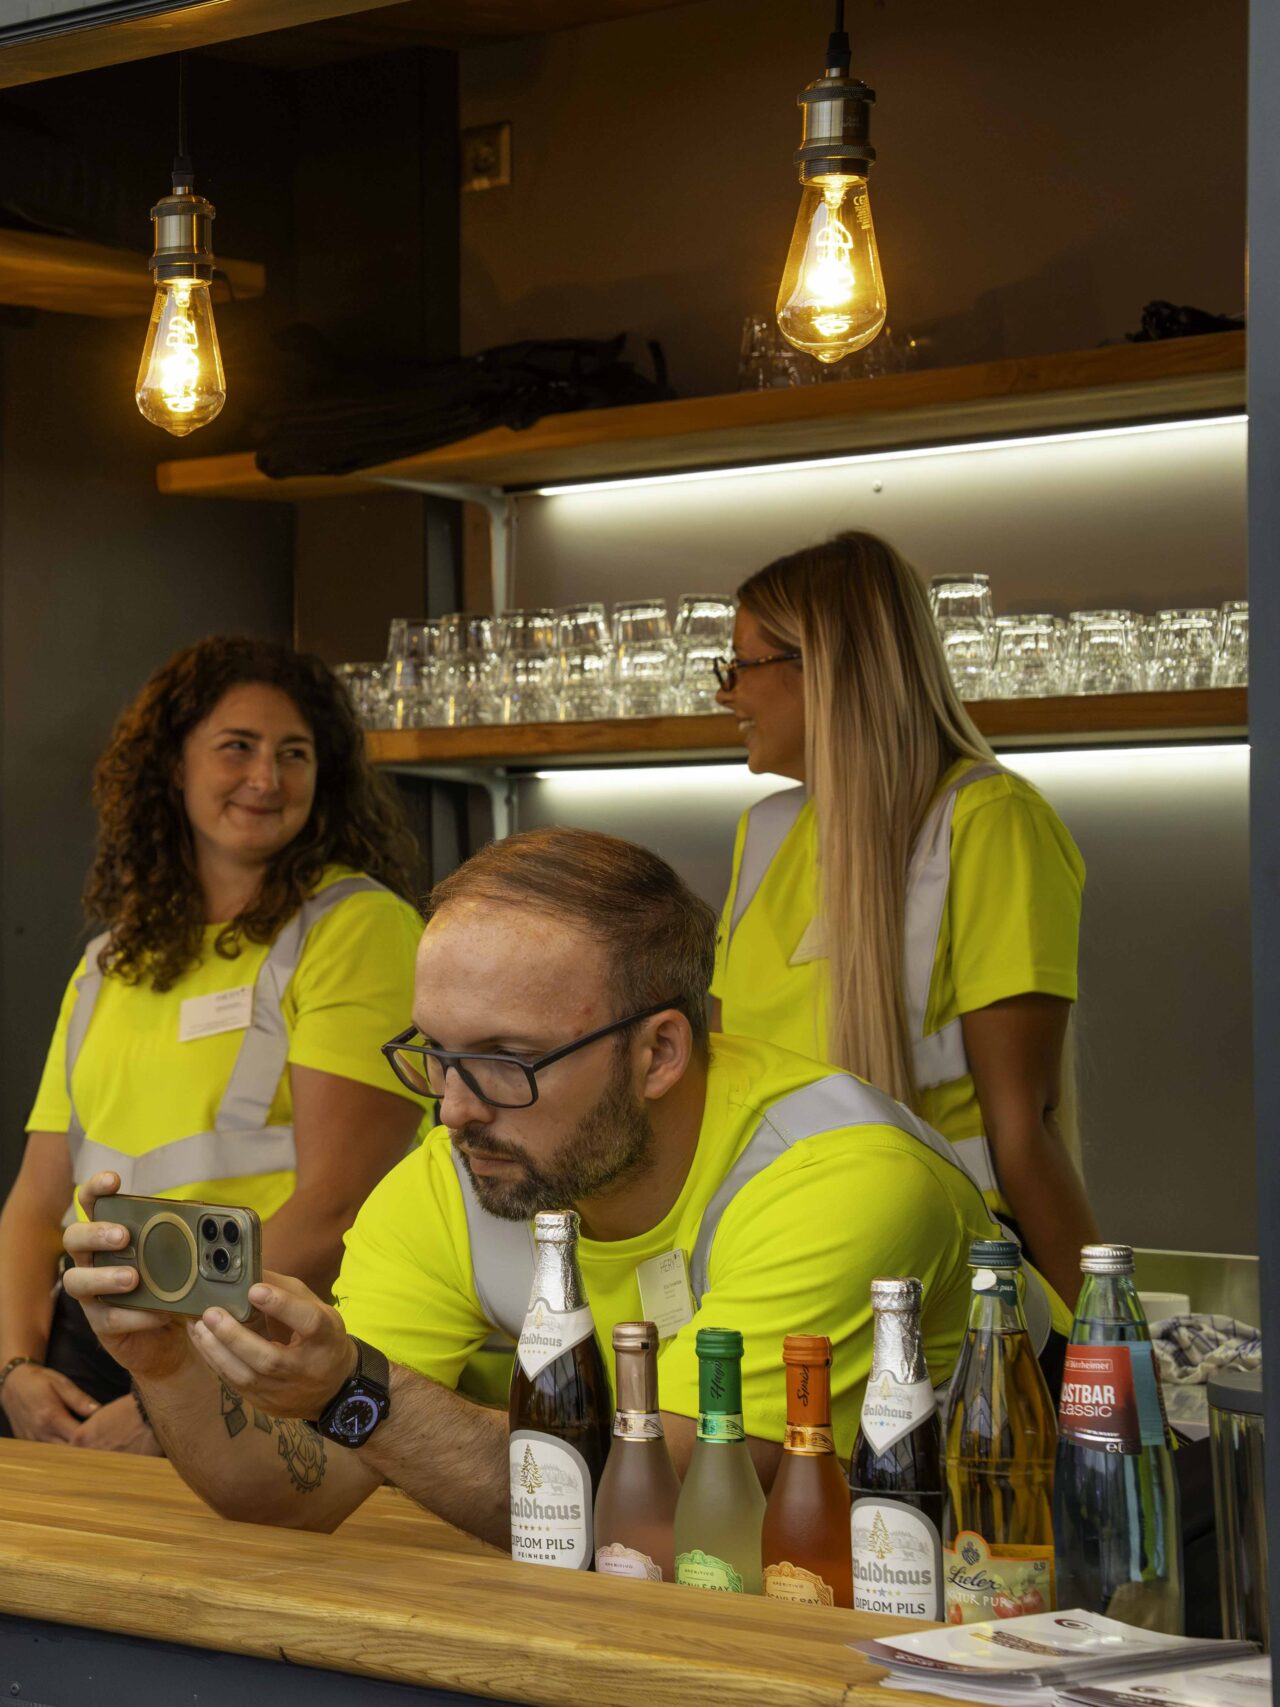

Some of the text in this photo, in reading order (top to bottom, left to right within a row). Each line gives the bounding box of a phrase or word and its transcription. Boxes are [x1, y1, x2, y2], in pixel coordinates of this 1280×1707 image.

[1061, 1382, 1116, 1405] OSTBAR
[546, 1538, 575, 1550] PILS
[855, 1597, 926, 1615] DIPLOM PILS
[983, 1595, 1013, 1609] PUR
